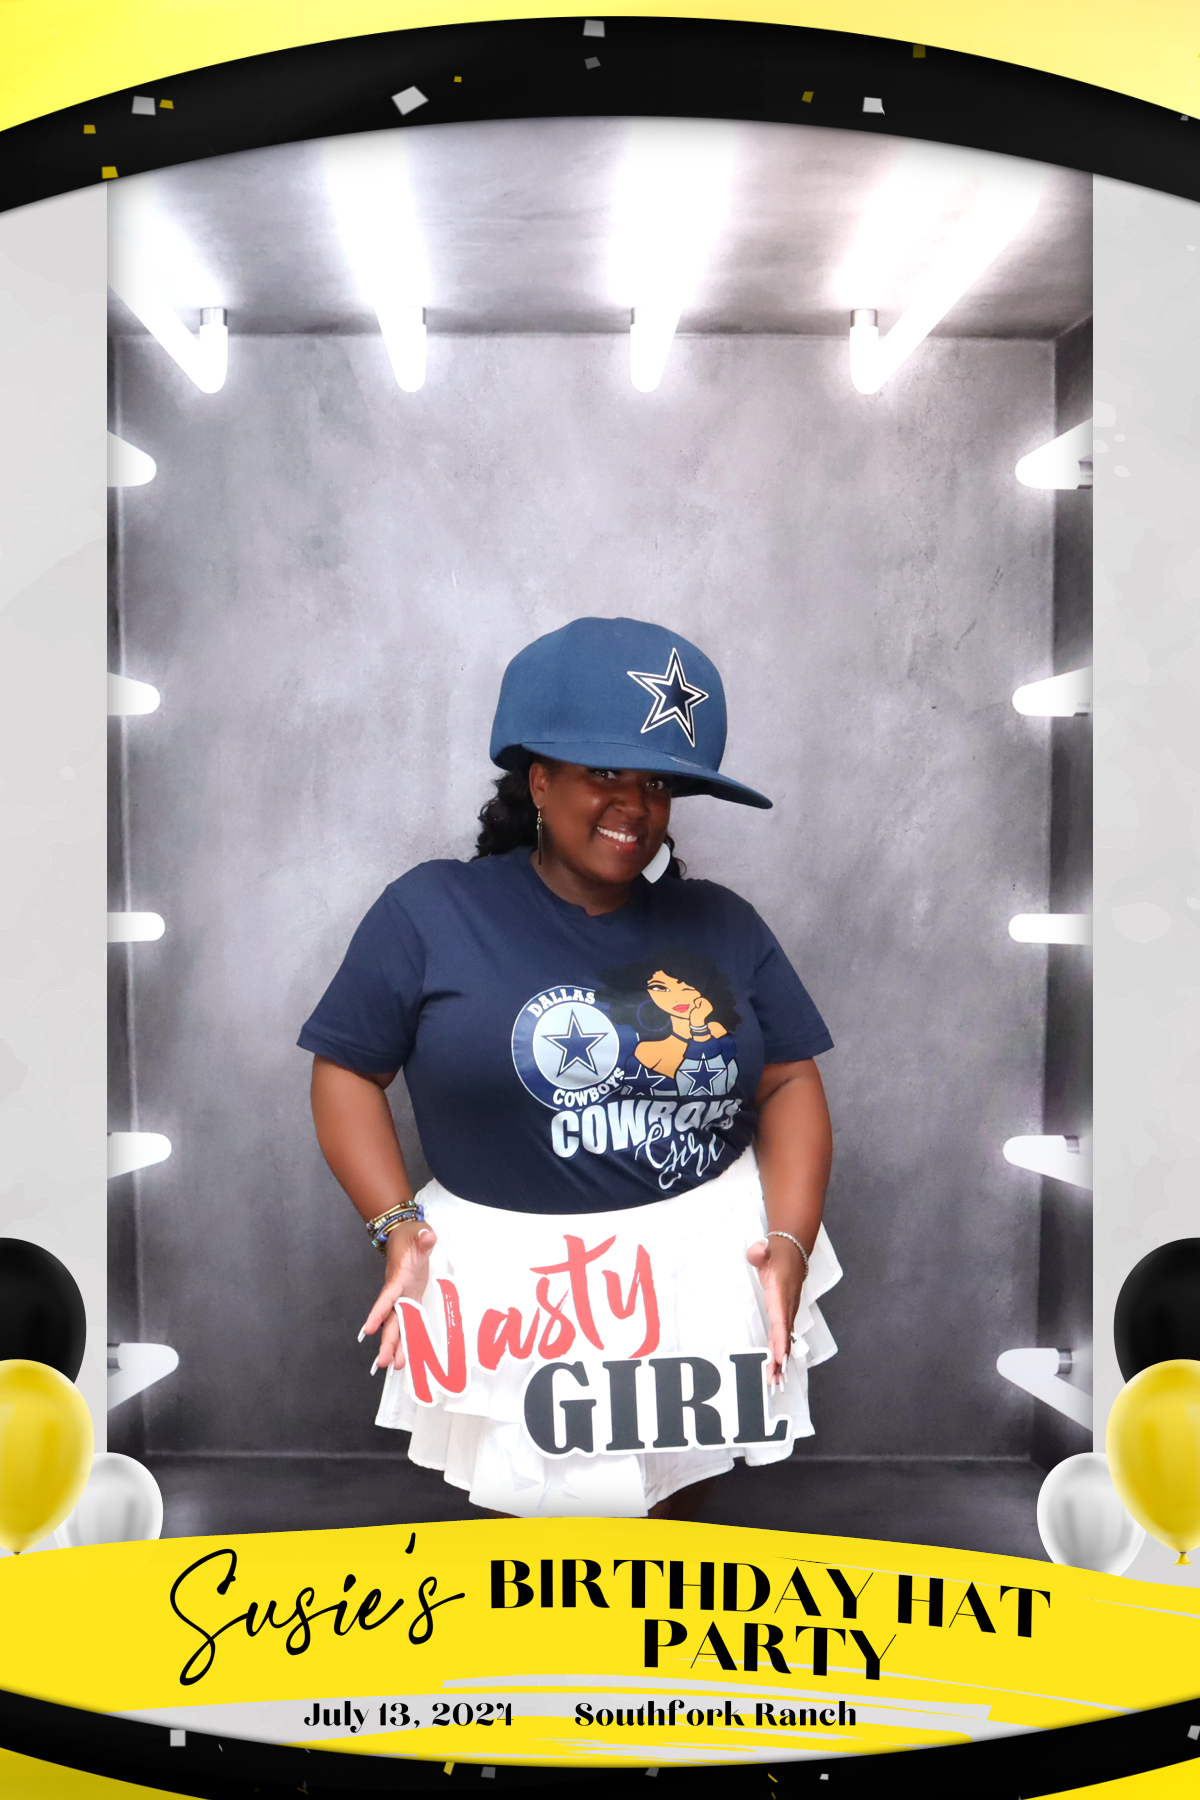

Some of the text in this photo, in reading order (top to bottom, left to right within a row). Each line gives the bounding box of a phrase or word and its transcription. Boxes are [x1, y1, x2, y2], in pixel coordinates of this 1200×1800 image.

[527, 988, 596, 1018] DALLAS
[552, 1066, 625, 1108] COWBOYS
[551, 1098, 743, 1160] COWBOYS
[634, 1121, 726, 1190] Girl
[399, 1233, 661, 1404] Nasty
[523, 1352, 789, 1454] GIRL
